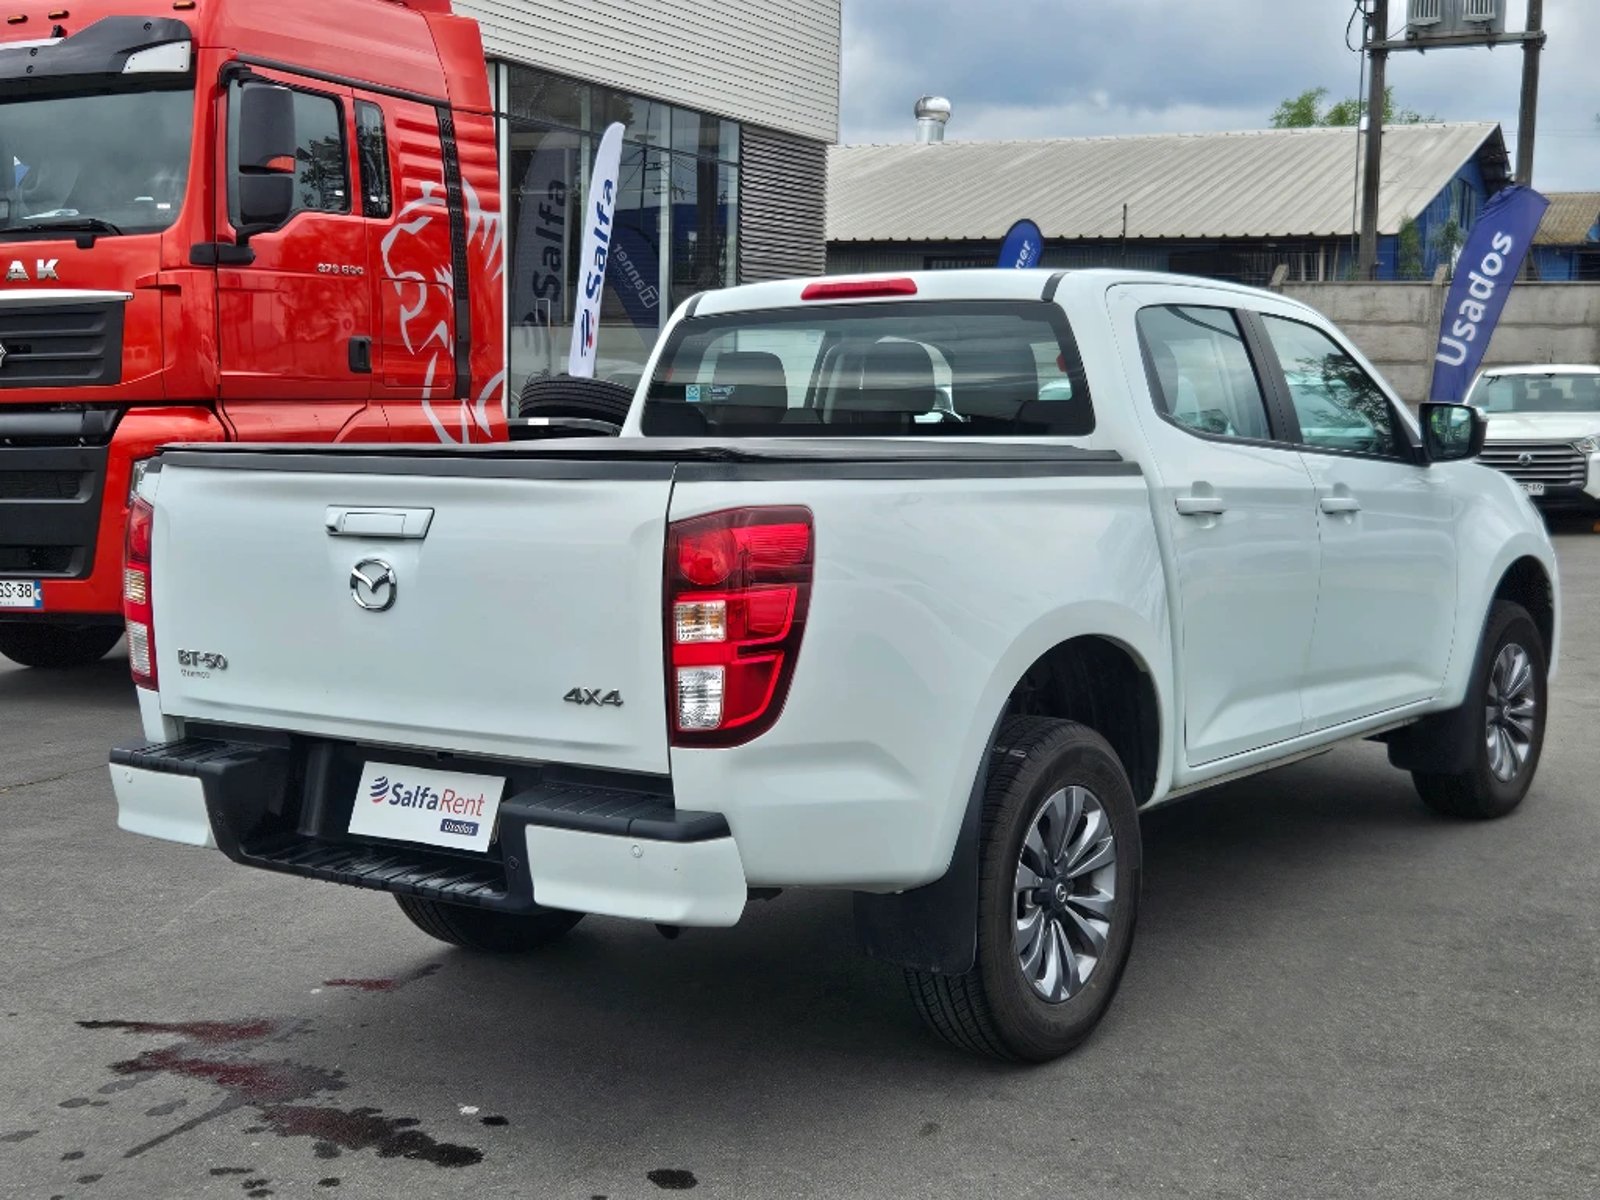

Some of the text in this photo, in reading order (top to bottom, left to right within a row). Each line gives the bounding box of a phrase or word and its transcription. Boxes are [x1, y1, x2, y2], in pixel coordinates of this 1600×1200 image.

[532, 179, 567, 303] Salfa
[585, 178, 614, 304] Salfa
[1434, 230, 1514, 367] Usados
[177, 648, 229, 671] BT-50
[388, 782, 486, 817] SalfaRent
[444, 820, 476, 835] Usados
